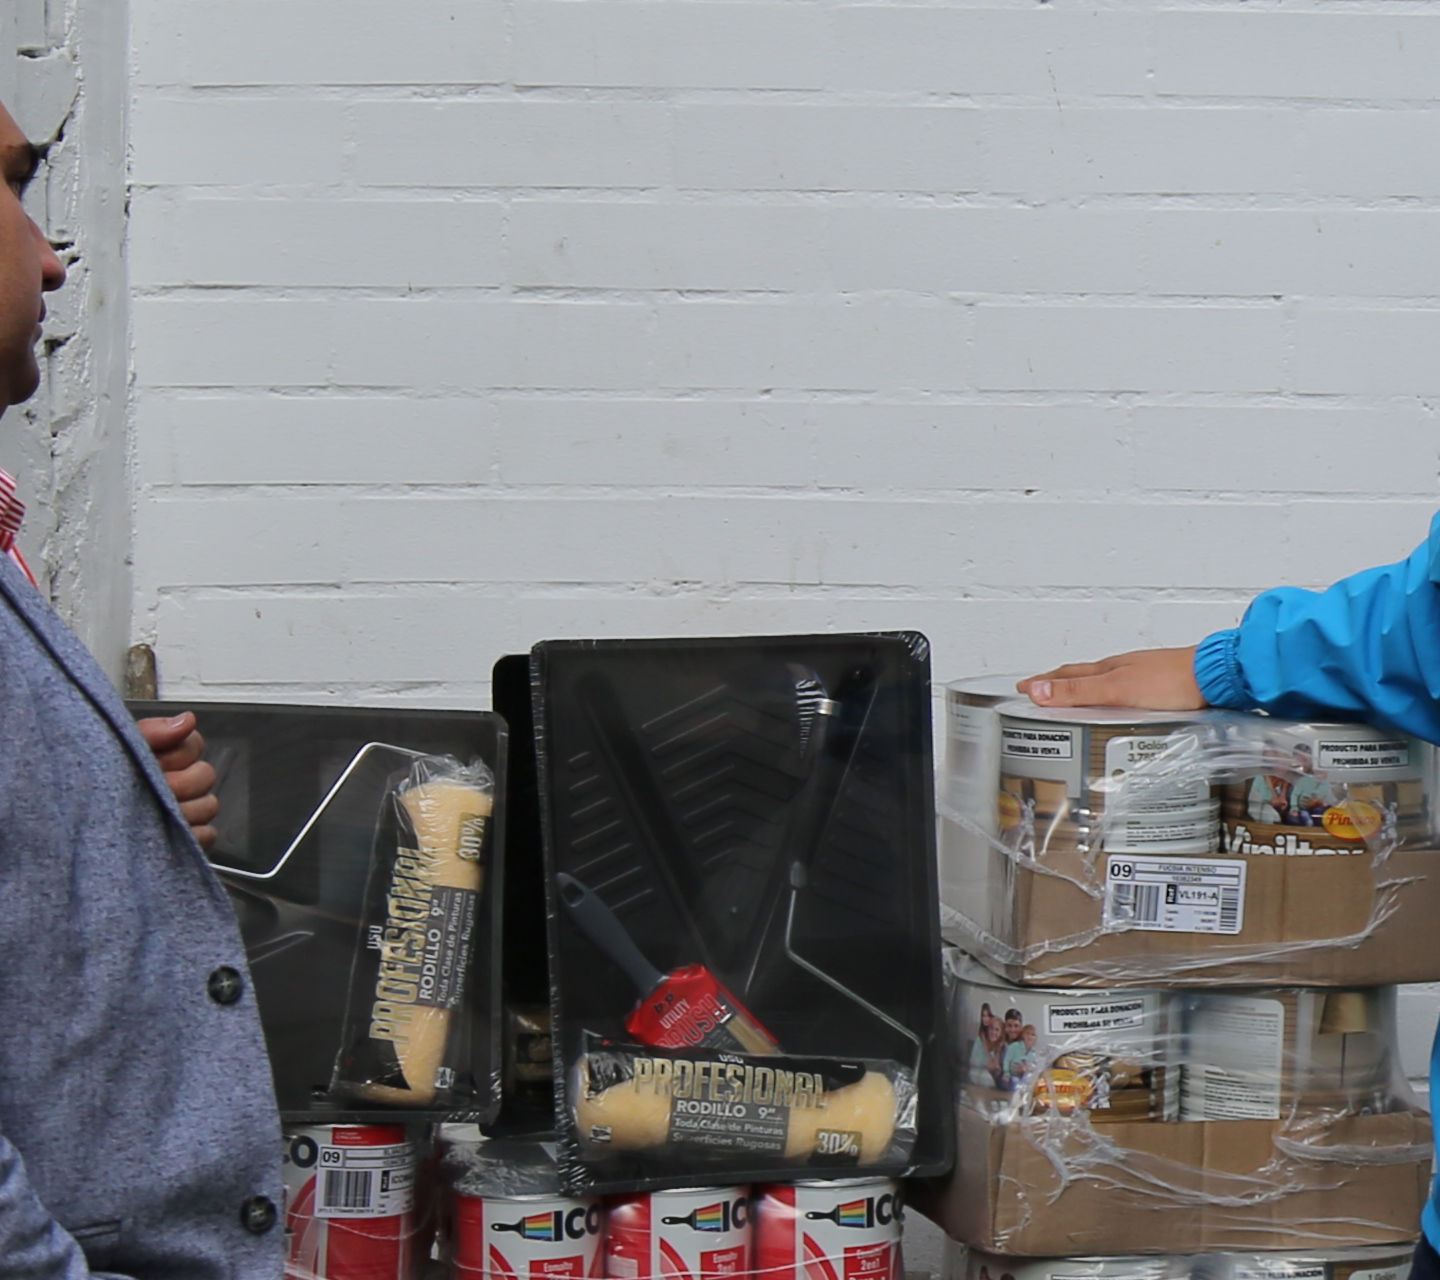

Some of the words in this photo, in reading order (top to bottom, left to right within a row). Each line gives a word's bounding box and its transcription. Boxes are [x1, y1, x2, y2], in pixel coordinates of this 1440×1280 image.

[1040, 747, 1060, 755] VENTA
[458, 817, 485, 862] 30%
[1222, 821, 1364, 856] Vinilt
[1111, 863, 1132, 878] 09
[1185, 865, 1217, 874] INTENSO
[1178, 890, 1218, 900] VL191-A
[448, 891, 463, 933] Pinturas
[461, 894, 477, 941] Rugosas
[367, 924, 384, 951] USO
[369, 845, 437, 1043] PROFESIONAL
[447, 934, 456, 951] de
[419, 927, 442, 1001] RODILLO
[441, 952, 453, 978] Clase
[437, 978, 449, 1003] Toda
[659, 998, 691, 1029] UTILITY
[718, 1053, 744, 1064] USO
[633, 1057, 827, 1110] PROFESIONAL
[676, 1100, 746, 1117] RODILLO
[674, 1118, 698, 1128] Toda
[699, 1119, 727, 1131] Clase
[728, 1122, 742, 1132] de
[744, 1123, 784, 1136] Pinturas
[735, 1137, 782, 1151] Rugosas
[817, 1131, 858, 1155] 30%
[322, 1150, 341, 1164] 09
[554, 1203, 601, 1241] ICO
[722, 1196, 748, 1232] IC
[543, 1261, 574, 1273] Esmalte
[860, 1258, 881, 1271] 2en1
